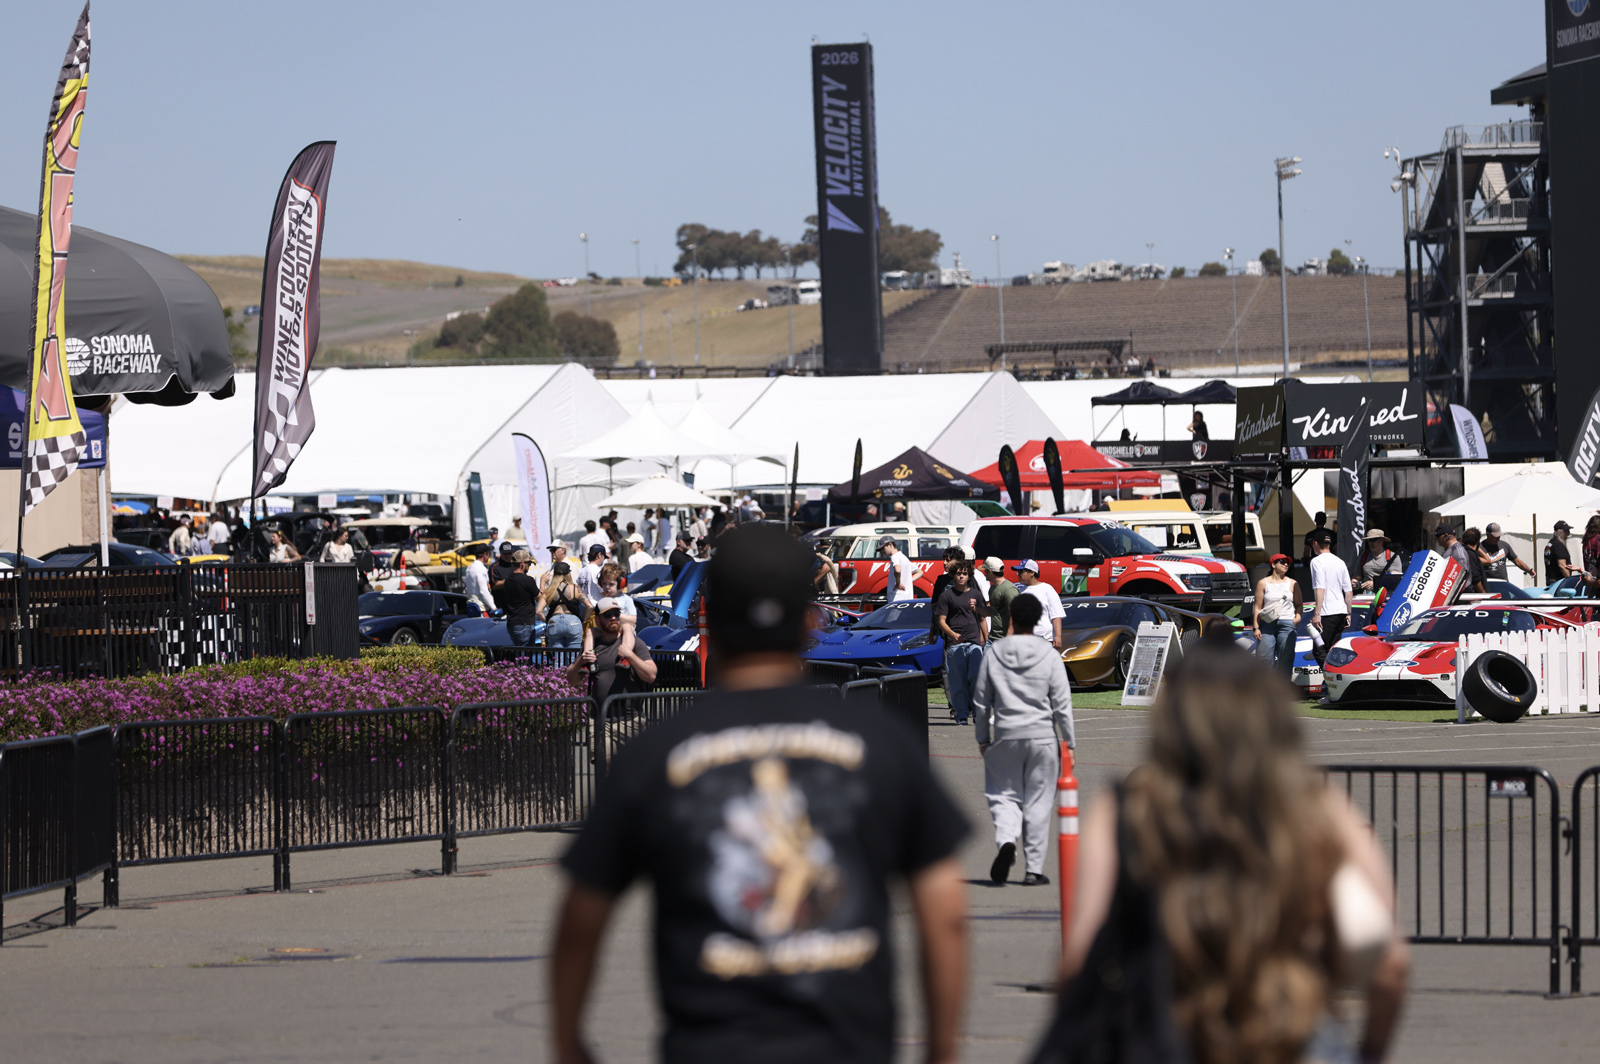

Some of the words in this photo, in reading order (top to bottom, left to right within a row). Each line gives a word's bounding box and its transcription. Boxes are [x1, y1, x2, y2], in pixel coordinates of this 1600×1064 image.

[1556, 27, 1578, 48] SONOMA
[1579, 21, 1600, 43] RACEWA
[821, 52, 859, 65] 2026
[821, 74, 851, 195] VELOCITY
[850, 99, 864, 197] INVITATIONAL
[279, 190, 306, 314] COUNTRY
[283, 299, 304, 391] MOTOR
[296, 200, 313, 298] SPORTS
[91, 334, 154, 355] SONOMA
[273, 315, 293, 382] WINE
[93, 354, 162, 375] RACEWAY
[1237, 394, 1281, 445] Kindred
[1292, 388, 1418, 440] Kinred
[1144, 446, 1159, 455] SKIN
[1574, 401, 1600, 484] OCITY
[1342, 460, 1366, 557] Kindred
[1063, 575, 1085, 594] 67
[1402, 576, 1416, 599] Powered
[1410, 556, 1438, 602] EcoBoost
[1440, 578, 1453, 596] IHG
[886, 602, 926, 610] FOR
[1393, 605, 1411, 628] Ford
[1421, 610, 1489, 618] FORD
[1303, 667, 1324, 675] EcoB
